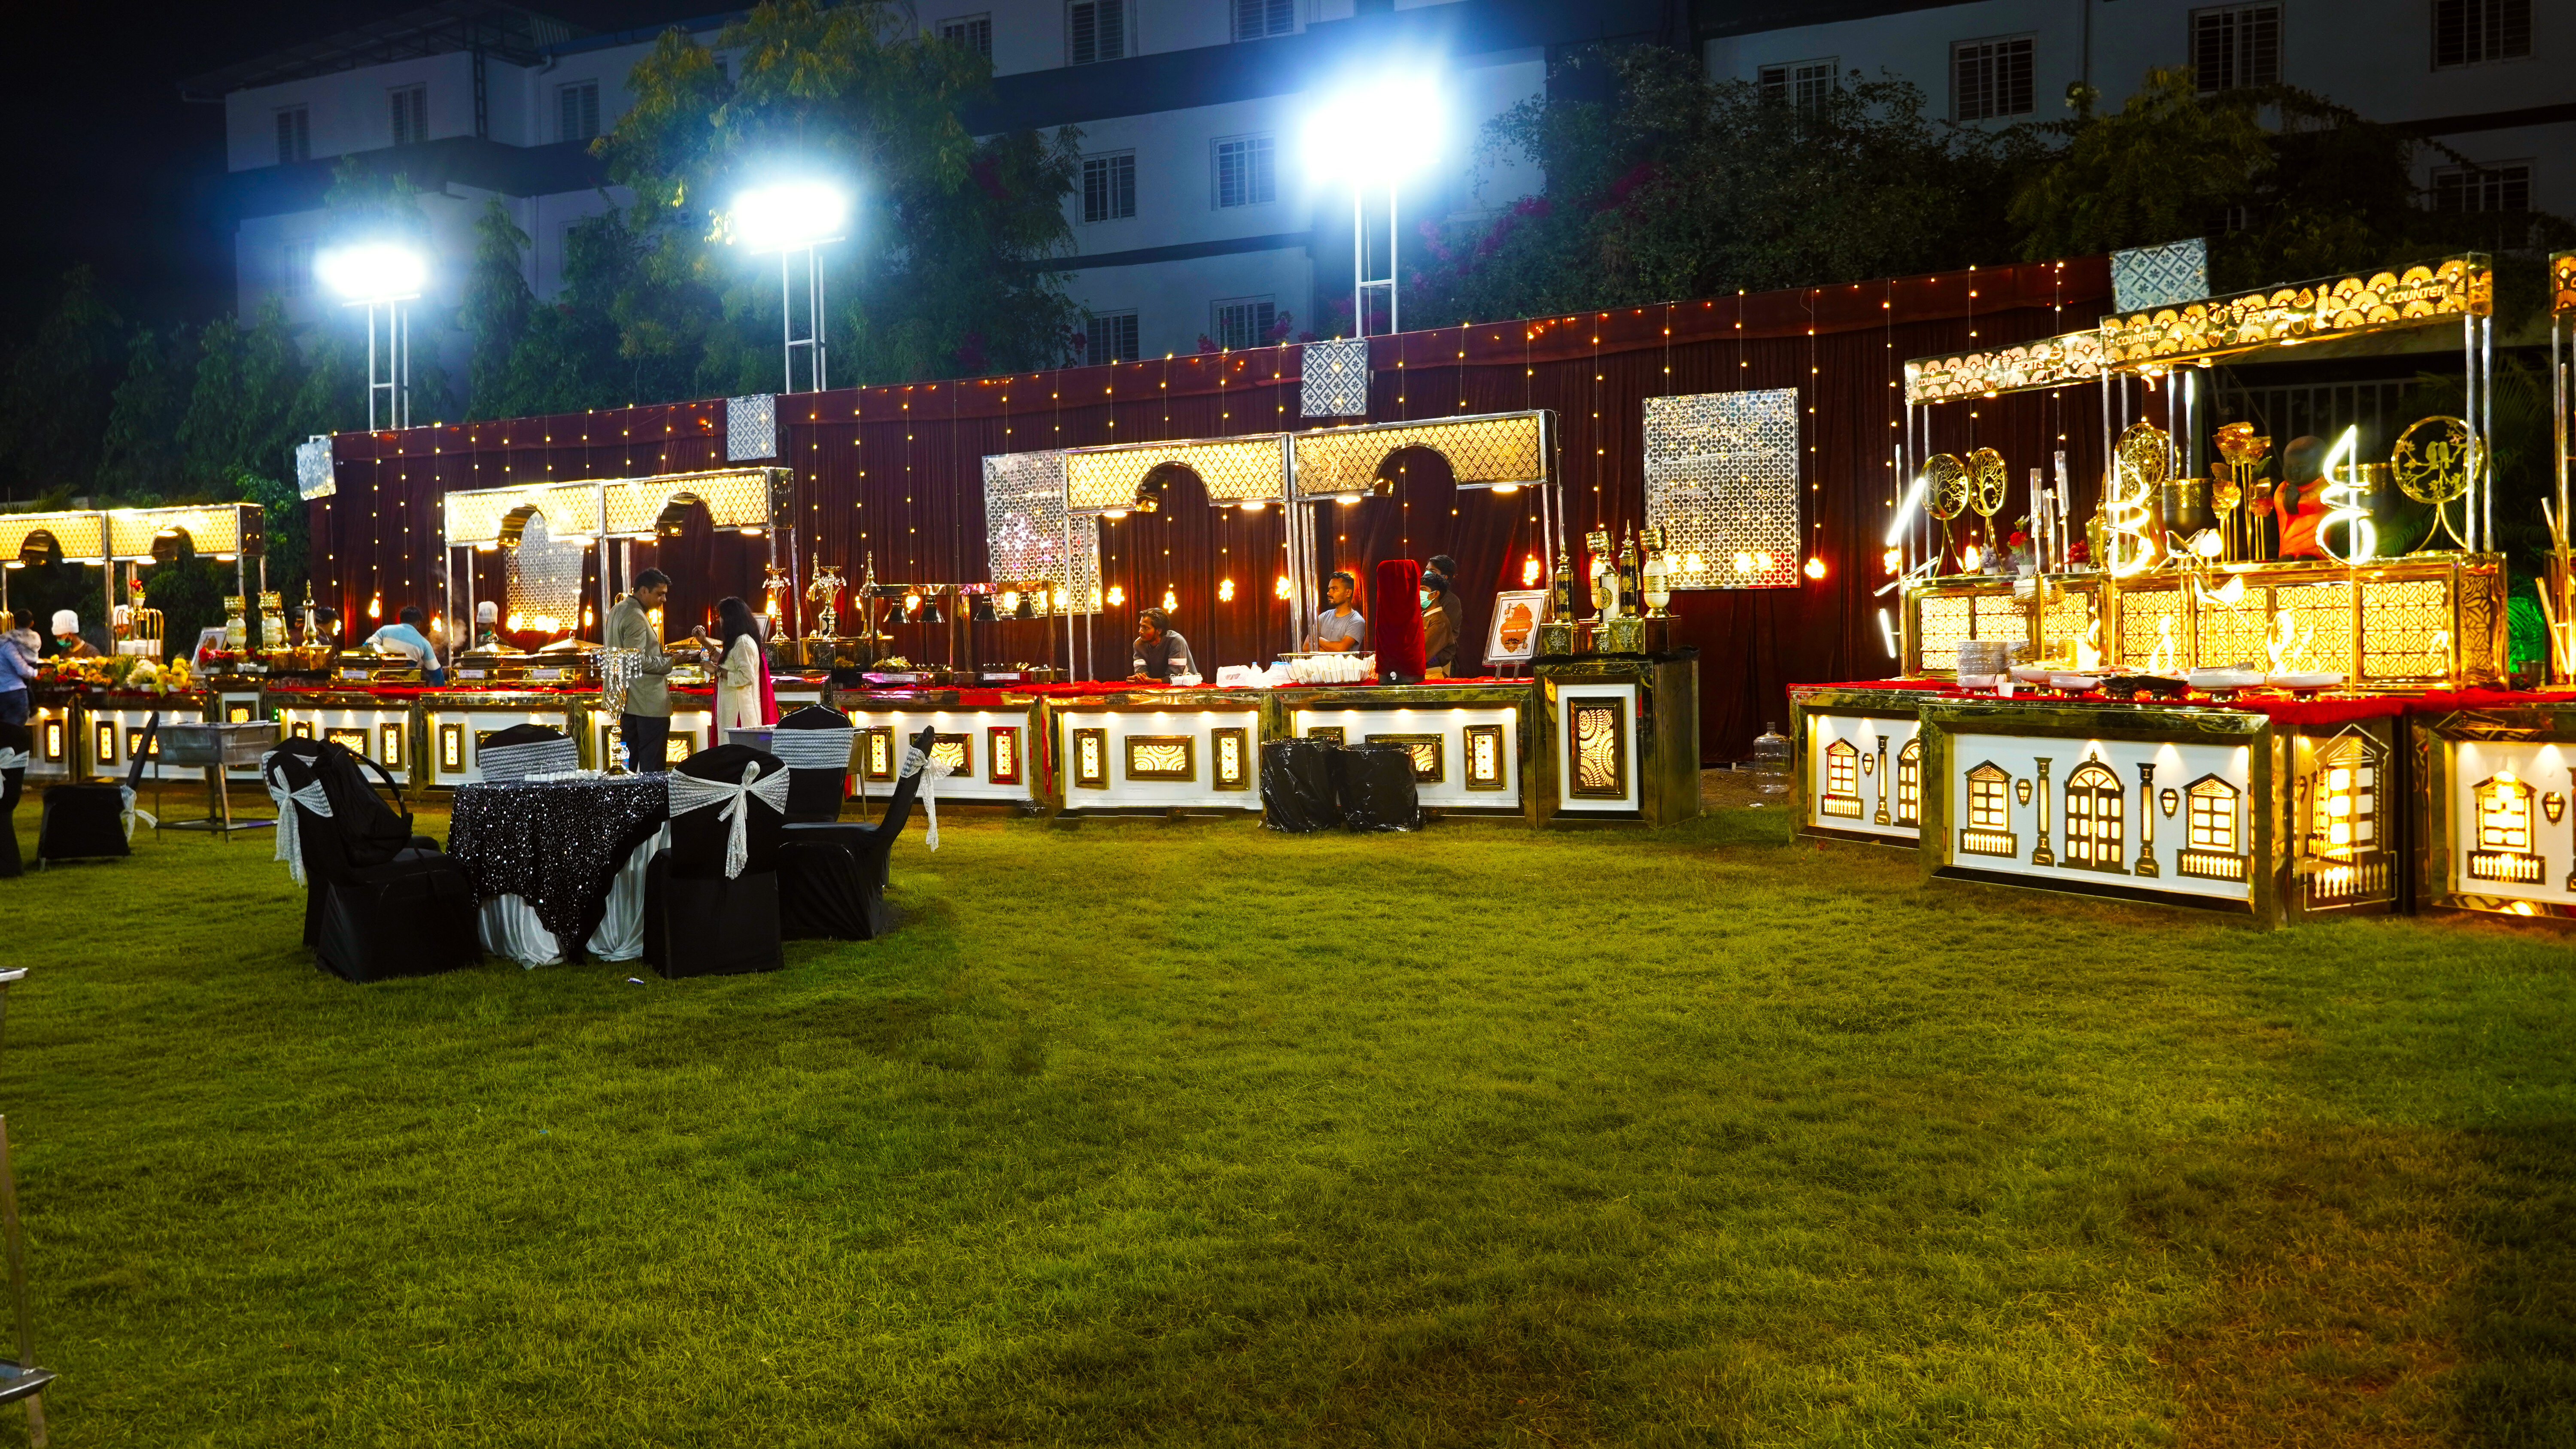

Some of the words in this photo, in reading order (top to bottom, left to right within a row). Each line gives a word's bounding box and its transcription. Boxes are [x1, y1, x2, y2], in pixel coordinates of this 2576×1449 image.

[2116, 330, 2162, 346] COUNTER
[2244, 306, 2289, 325] FRUITS
[2386, 285, 2447, 304] COUNTER
[1916, 374, 1950, 387] COUNTER
[2011, 359, 2044, 373] FRUITS
